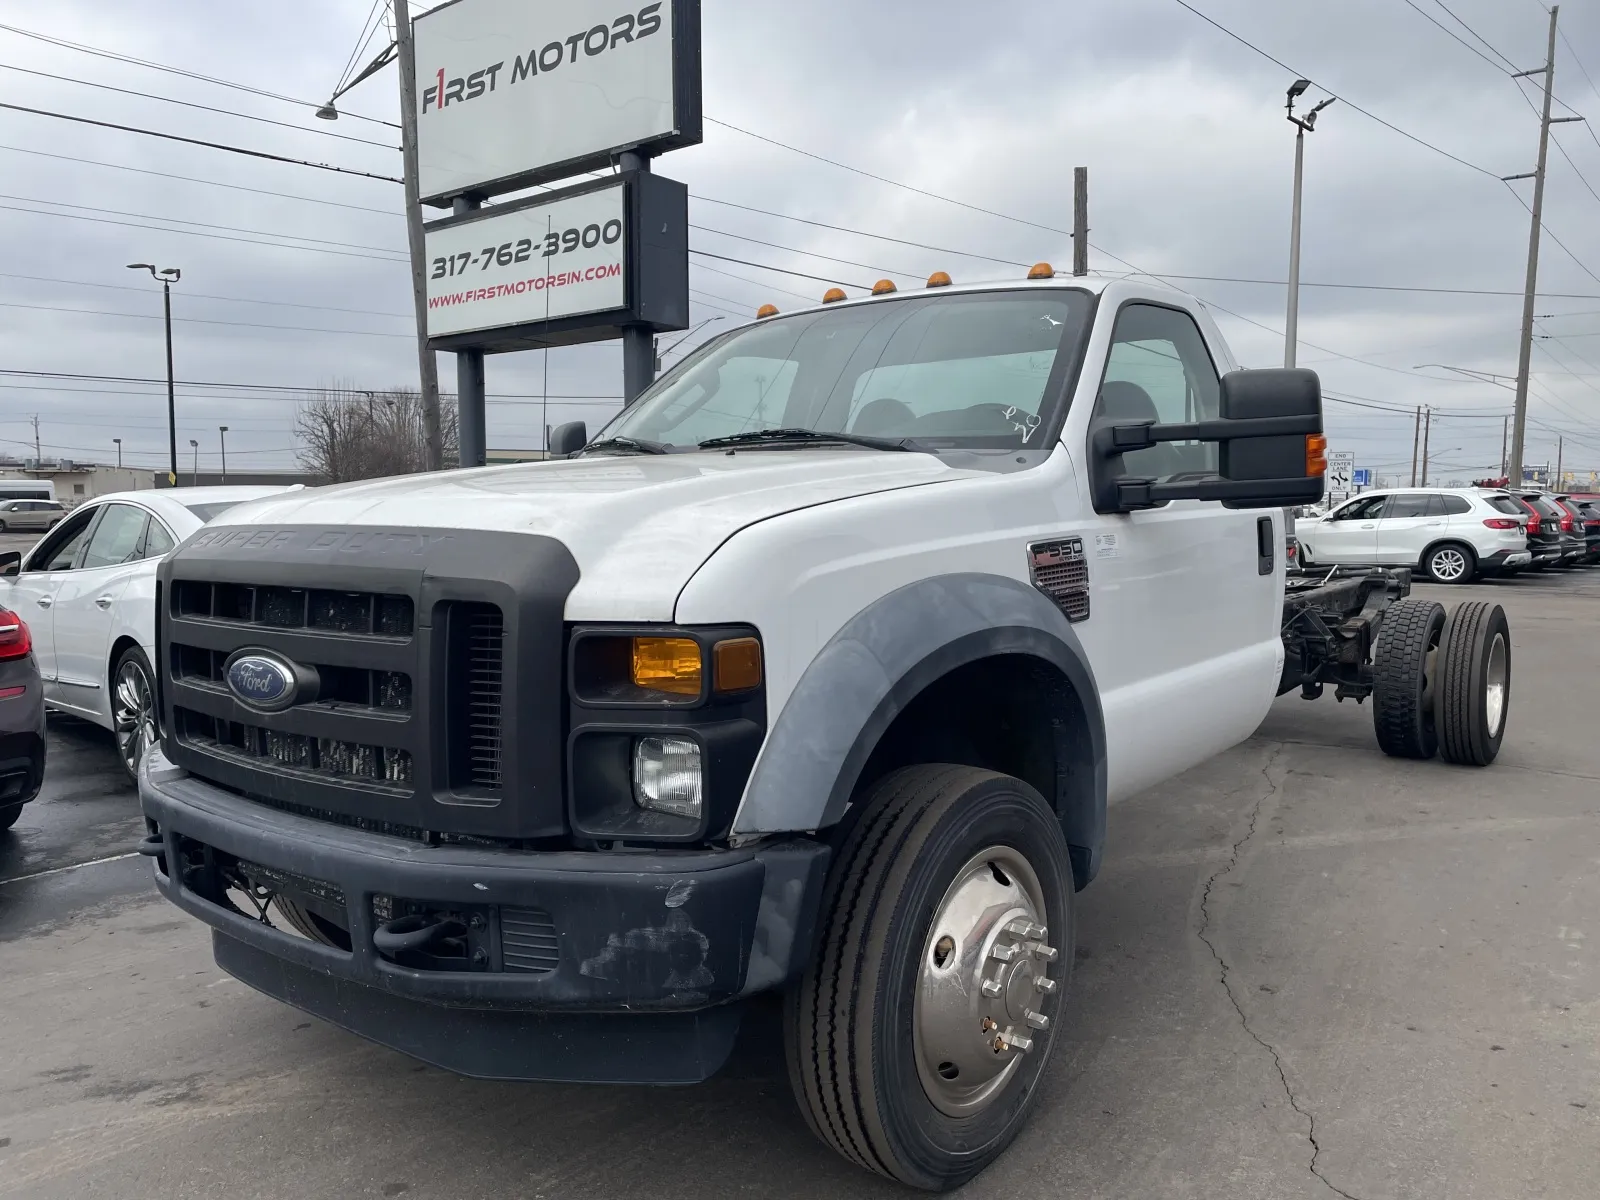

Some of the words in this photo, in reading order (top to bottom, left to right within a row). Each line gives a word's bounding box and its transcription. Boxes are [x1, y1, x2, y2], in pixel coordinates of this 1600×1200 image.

[511, 2, 662, 84] MOTORS
[431, 219, 622, 279] 317-762-3900
[429, 263, 621, 309] WWW.FIRSTMOTORSIN.COM
[240, 663, 273, 693] Ford
